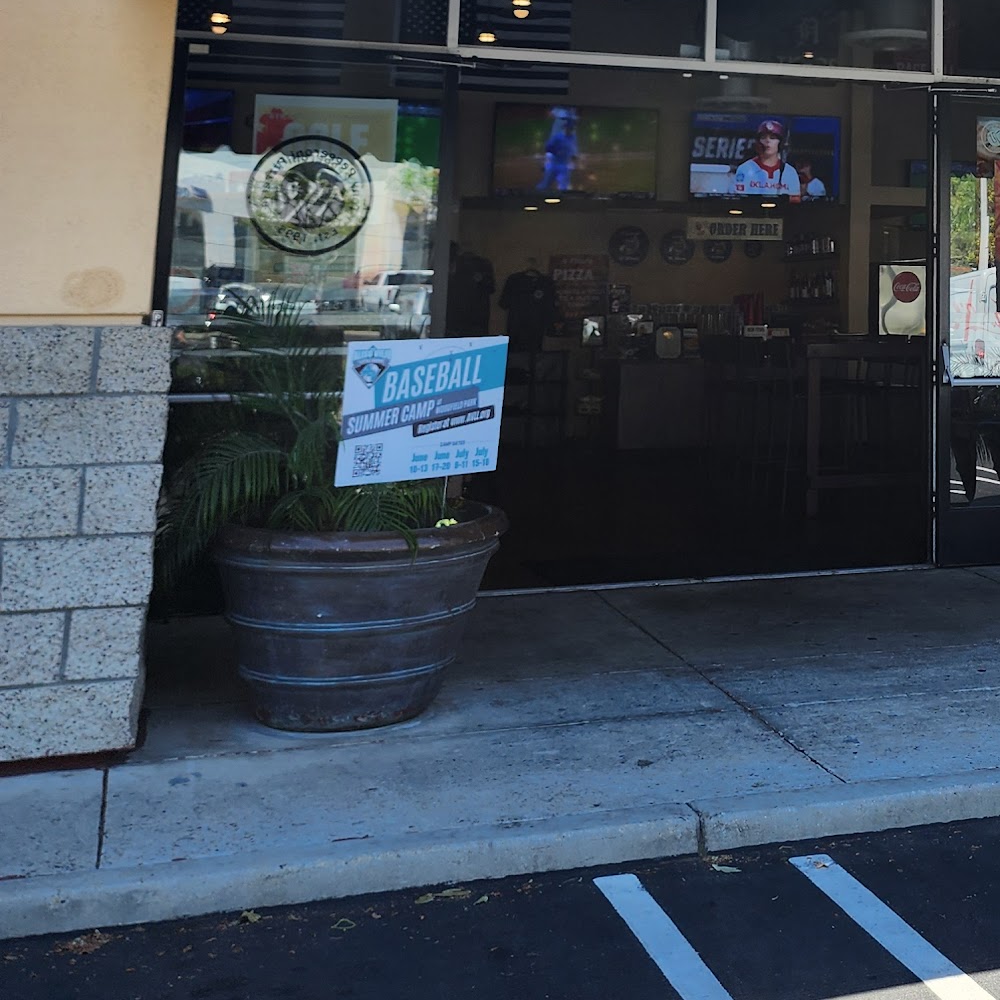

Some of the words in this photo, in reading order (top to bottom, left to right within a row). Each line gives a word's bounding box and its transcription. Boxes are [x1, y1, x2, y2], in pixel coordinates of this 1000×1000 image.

[709, 222, 748, 236] ORDER
[750, 223, 780, 236] HERE
[382, 354, 482, 403] BASEBALL
[346, 409, 399, 435] SUMMER
[401, 401, 435, 423] CAMP
[455, 449, 470, 460] July
[474, 446, 489, 458] July
